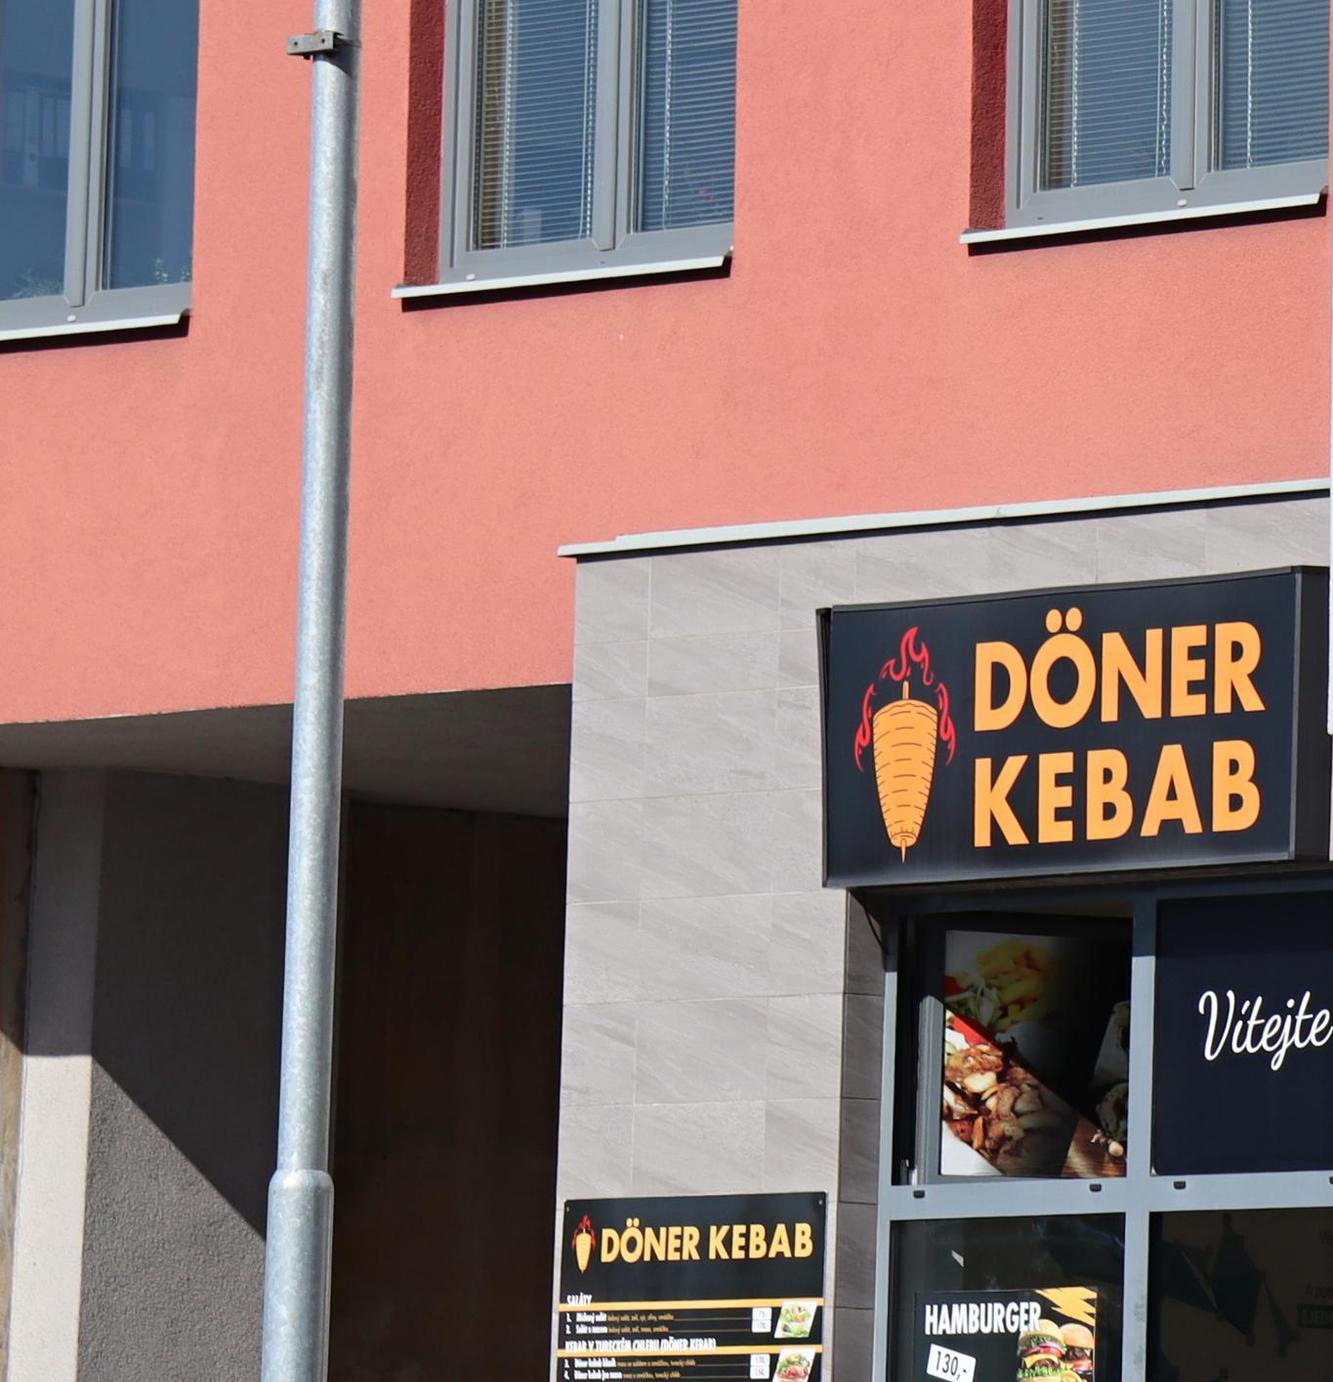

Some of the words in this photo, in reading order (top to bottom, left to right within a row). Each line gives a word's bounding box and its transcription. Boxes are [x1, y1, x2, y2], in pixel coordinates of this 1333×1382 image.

[974, 606, 1265, 733] DÖNER
[974, 739, 1262, 848] KEBAB
[600, 1217, 701, 1263] DÖNER
[708, 1222, 814, 1260] KEBAB
[925, 1301, 1041, 1335] HAMBURGER
[936, 1351, 967, 1382] 130,-
